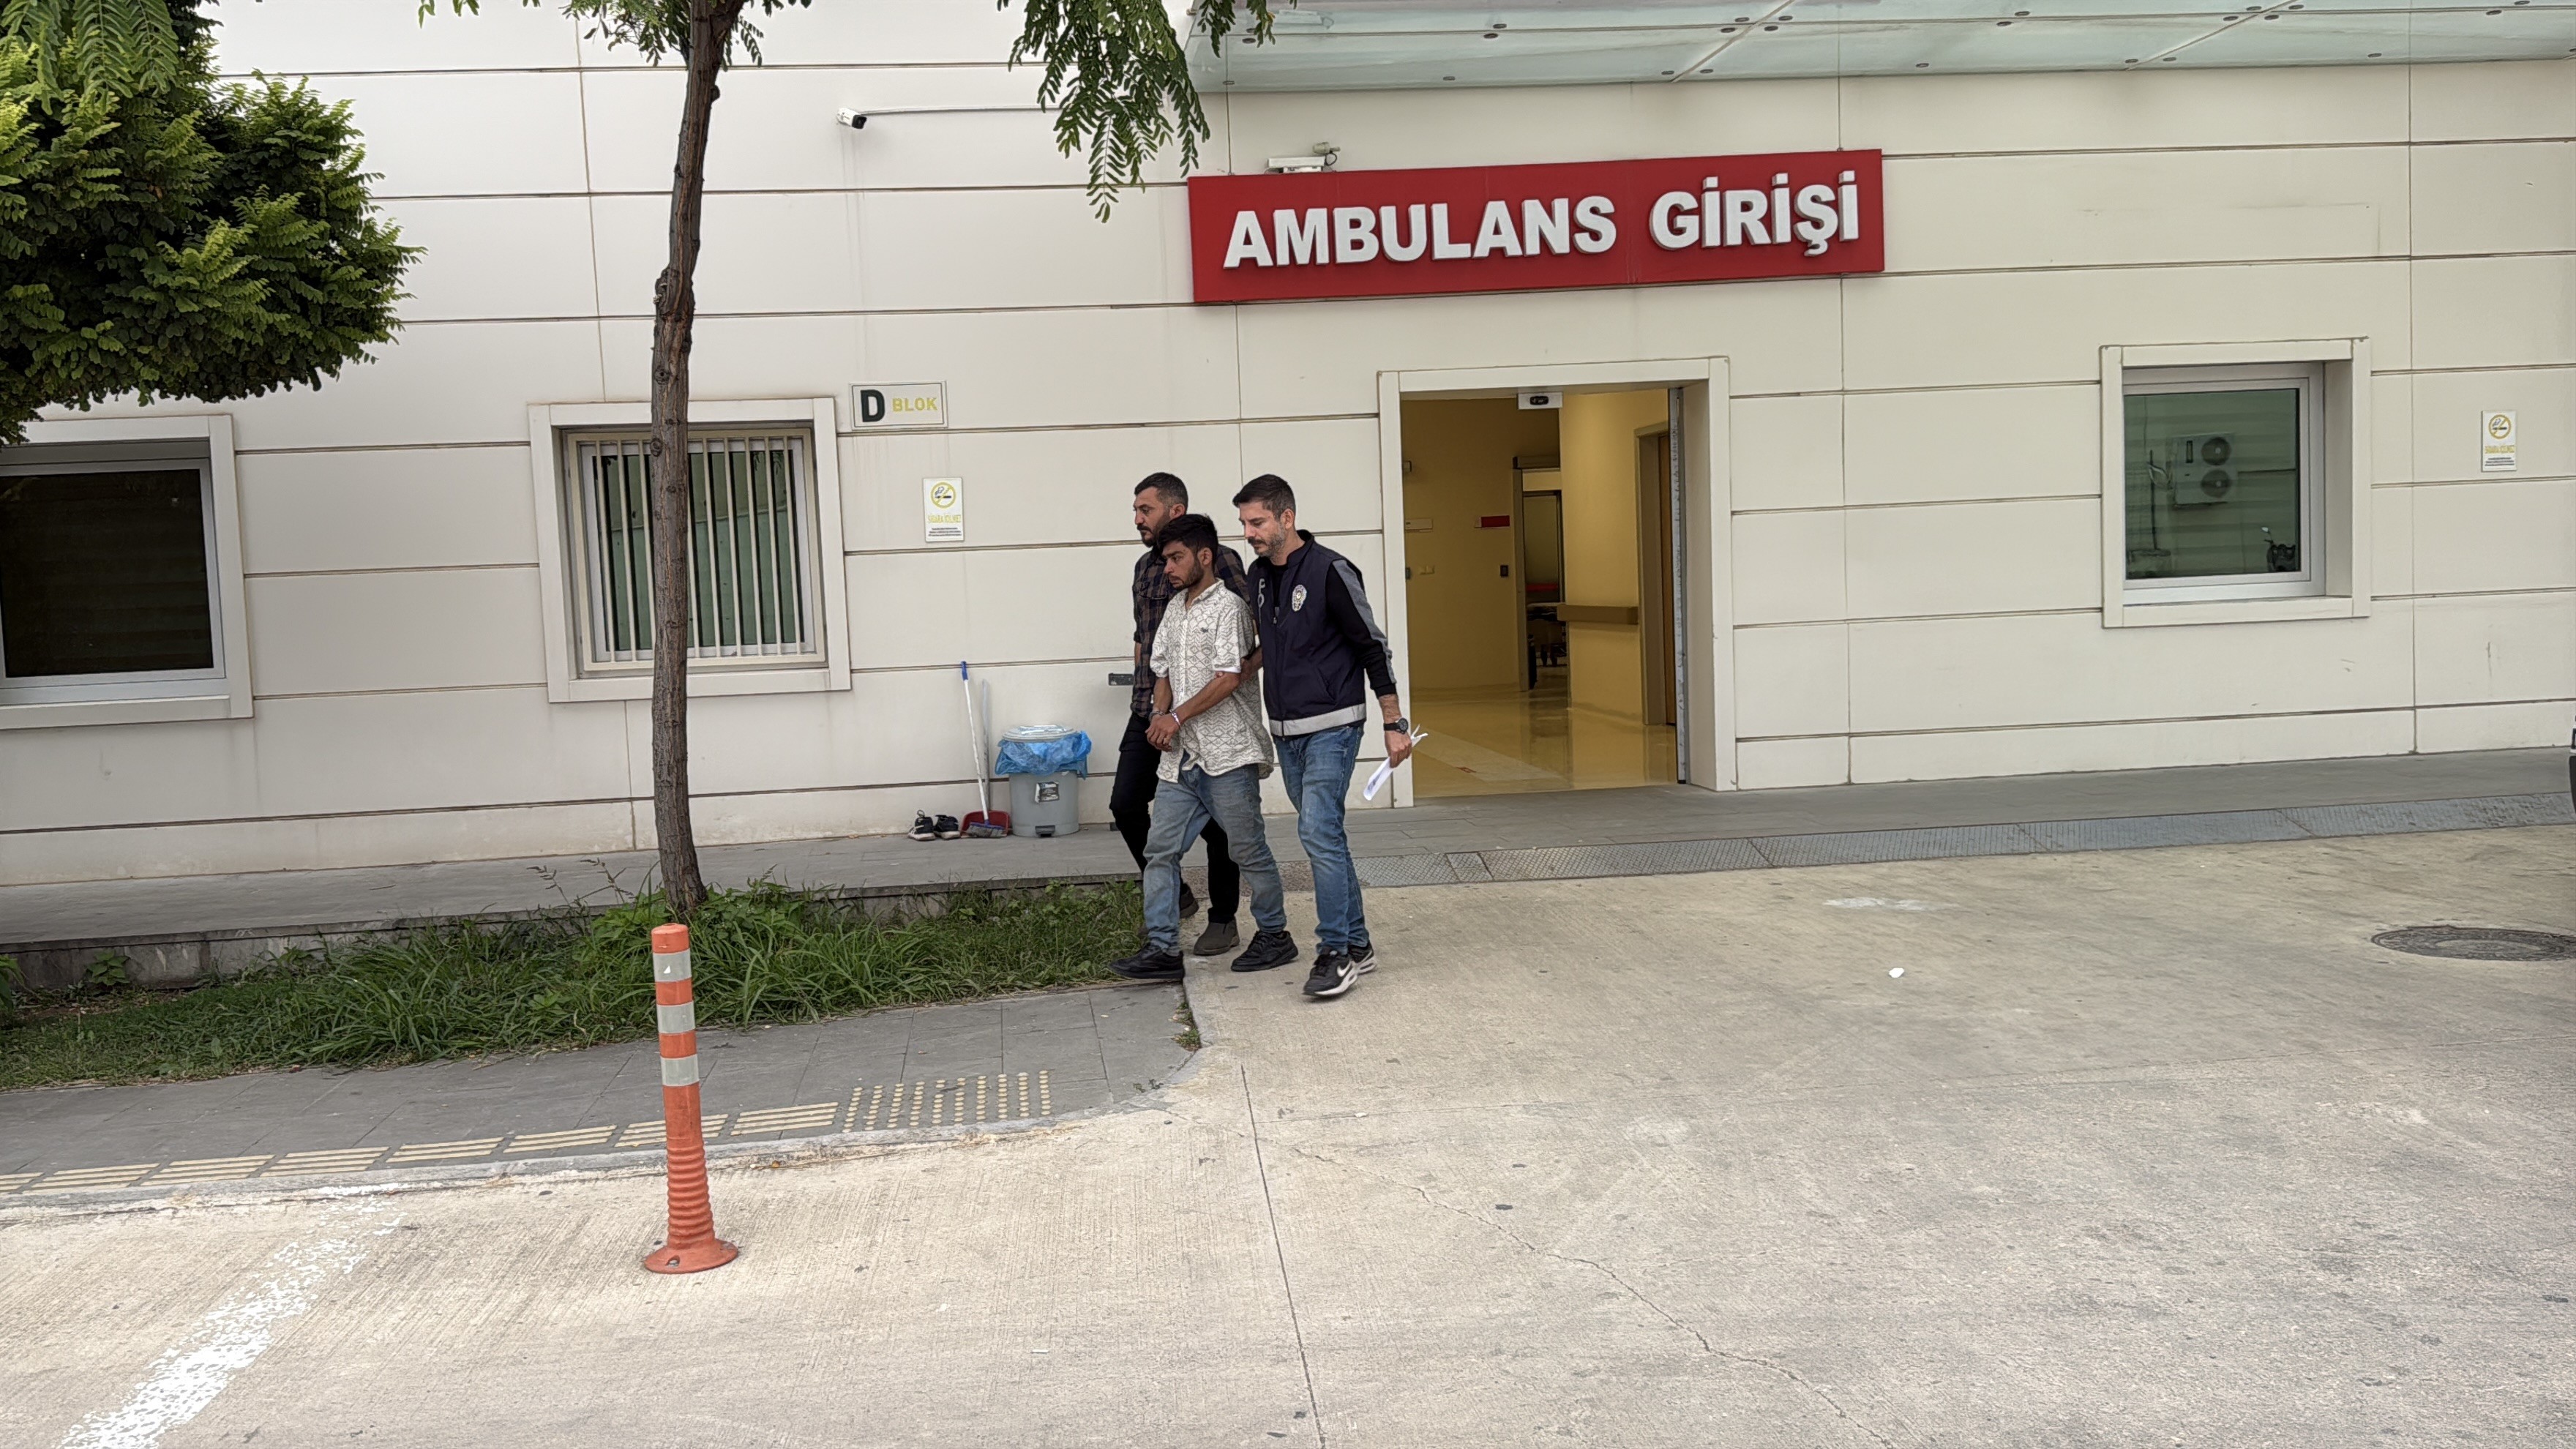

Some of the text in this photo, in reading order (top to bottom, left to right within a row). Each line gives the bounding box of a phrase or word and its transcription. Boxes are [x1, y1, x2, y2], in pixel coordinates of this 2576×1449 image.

[1223, 170, 1860, 269] AMBULANS GİRİŞİ
[860, 389, 937, 422] D BLOK
